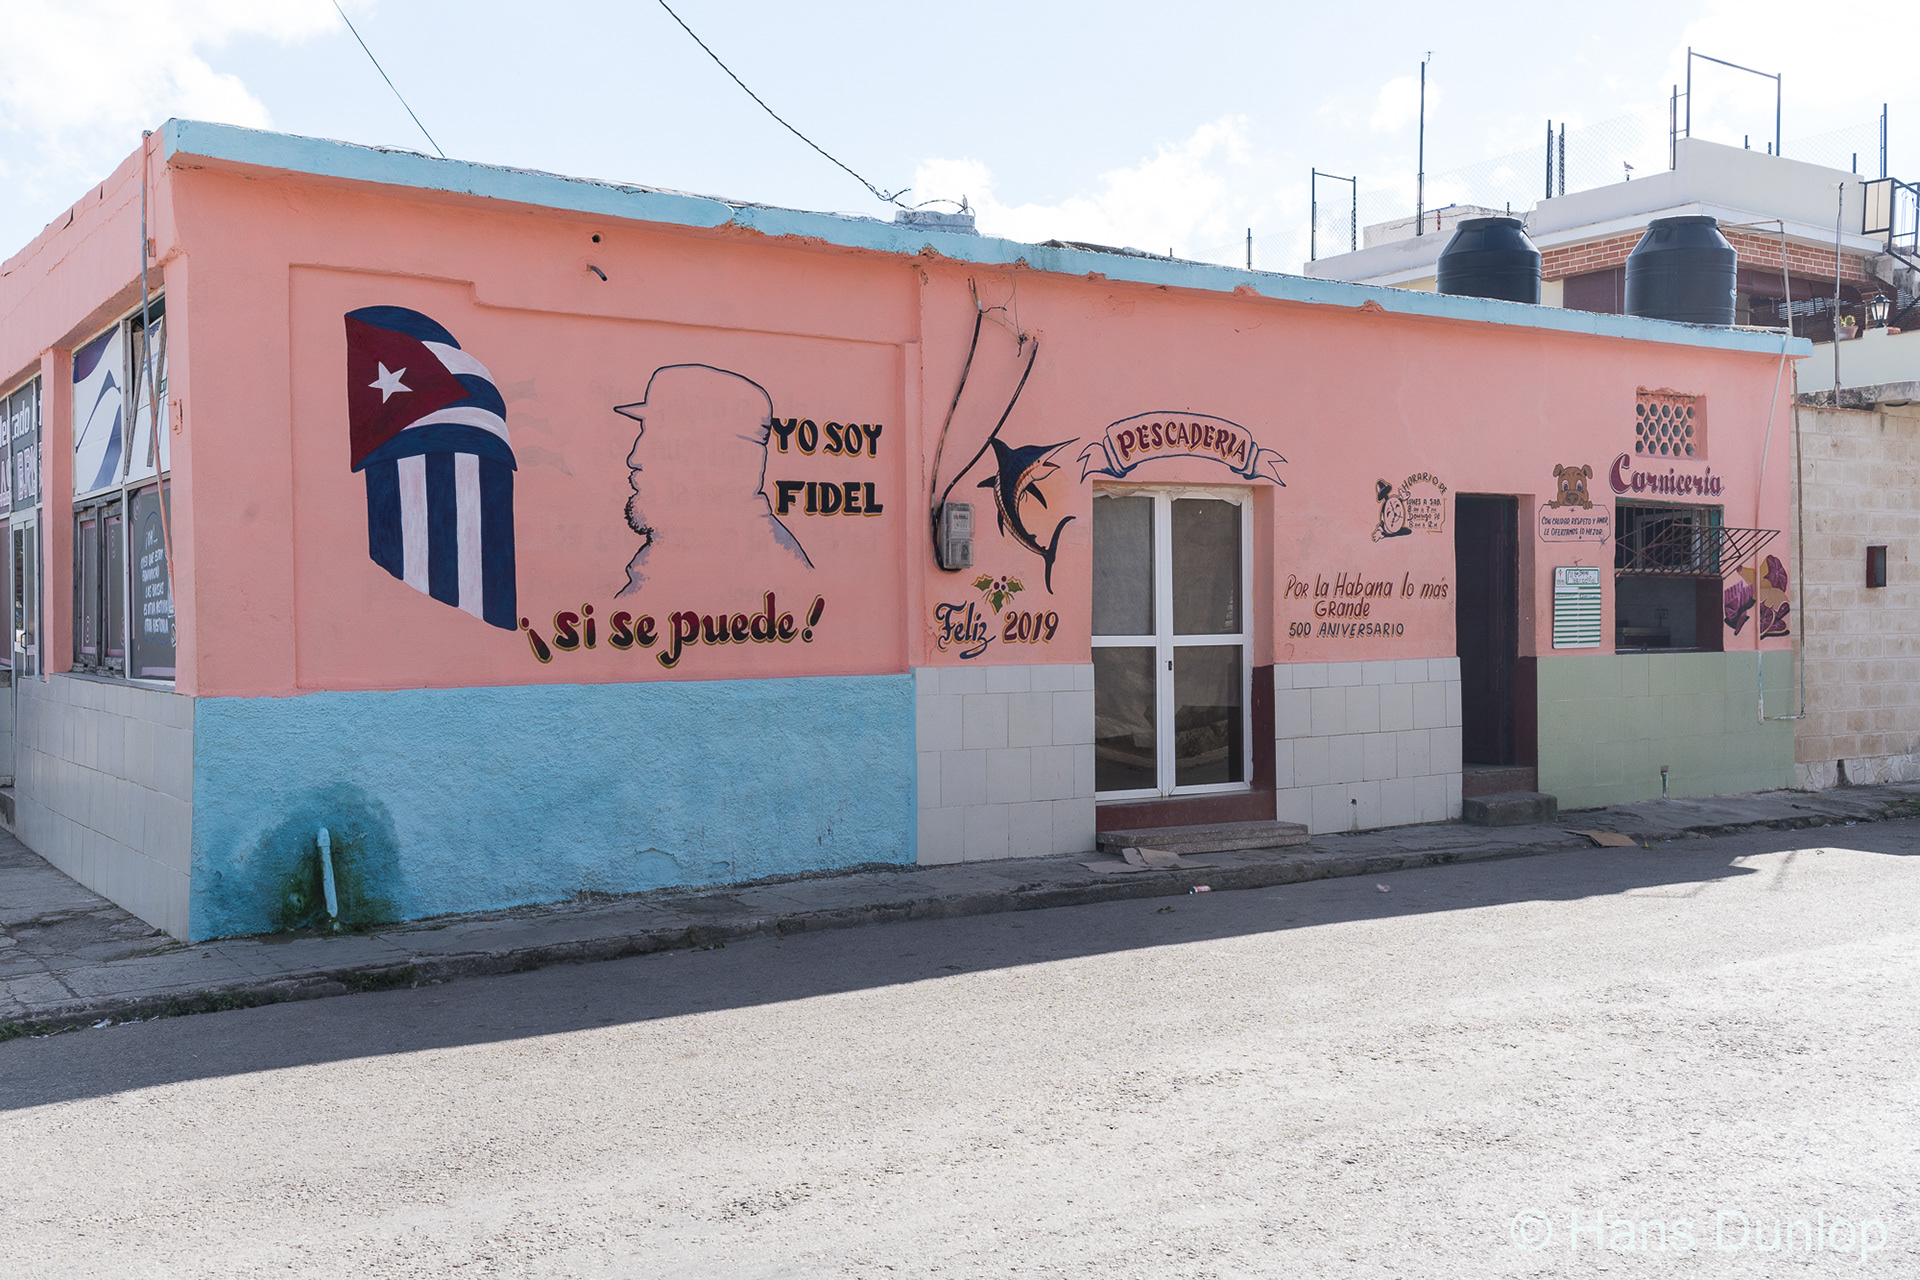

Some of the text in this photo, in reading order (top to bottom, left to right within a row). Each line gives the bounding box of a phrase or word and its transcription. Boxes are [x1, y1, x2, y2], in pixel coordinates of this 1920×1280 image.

[771, 418, 819, 456] YO
[822, 421, 883, 458] SOY
[1116, 421, 1246, 465] PESCADERIA
[773, 480, 883, 517] FIDEL
[1401, 472, 1447, 496] HORARIO DE
[1333, 572, 1394, 599] Habana
[1419, 576, 1448, 599] más
[608, 610, 659, 650] se
[656, 590, 825, 668] puede!
[933, 600, 1059, 659] Feliz 2019
[1288, 622, 1405, 638] 500 ANIVERSARIO
